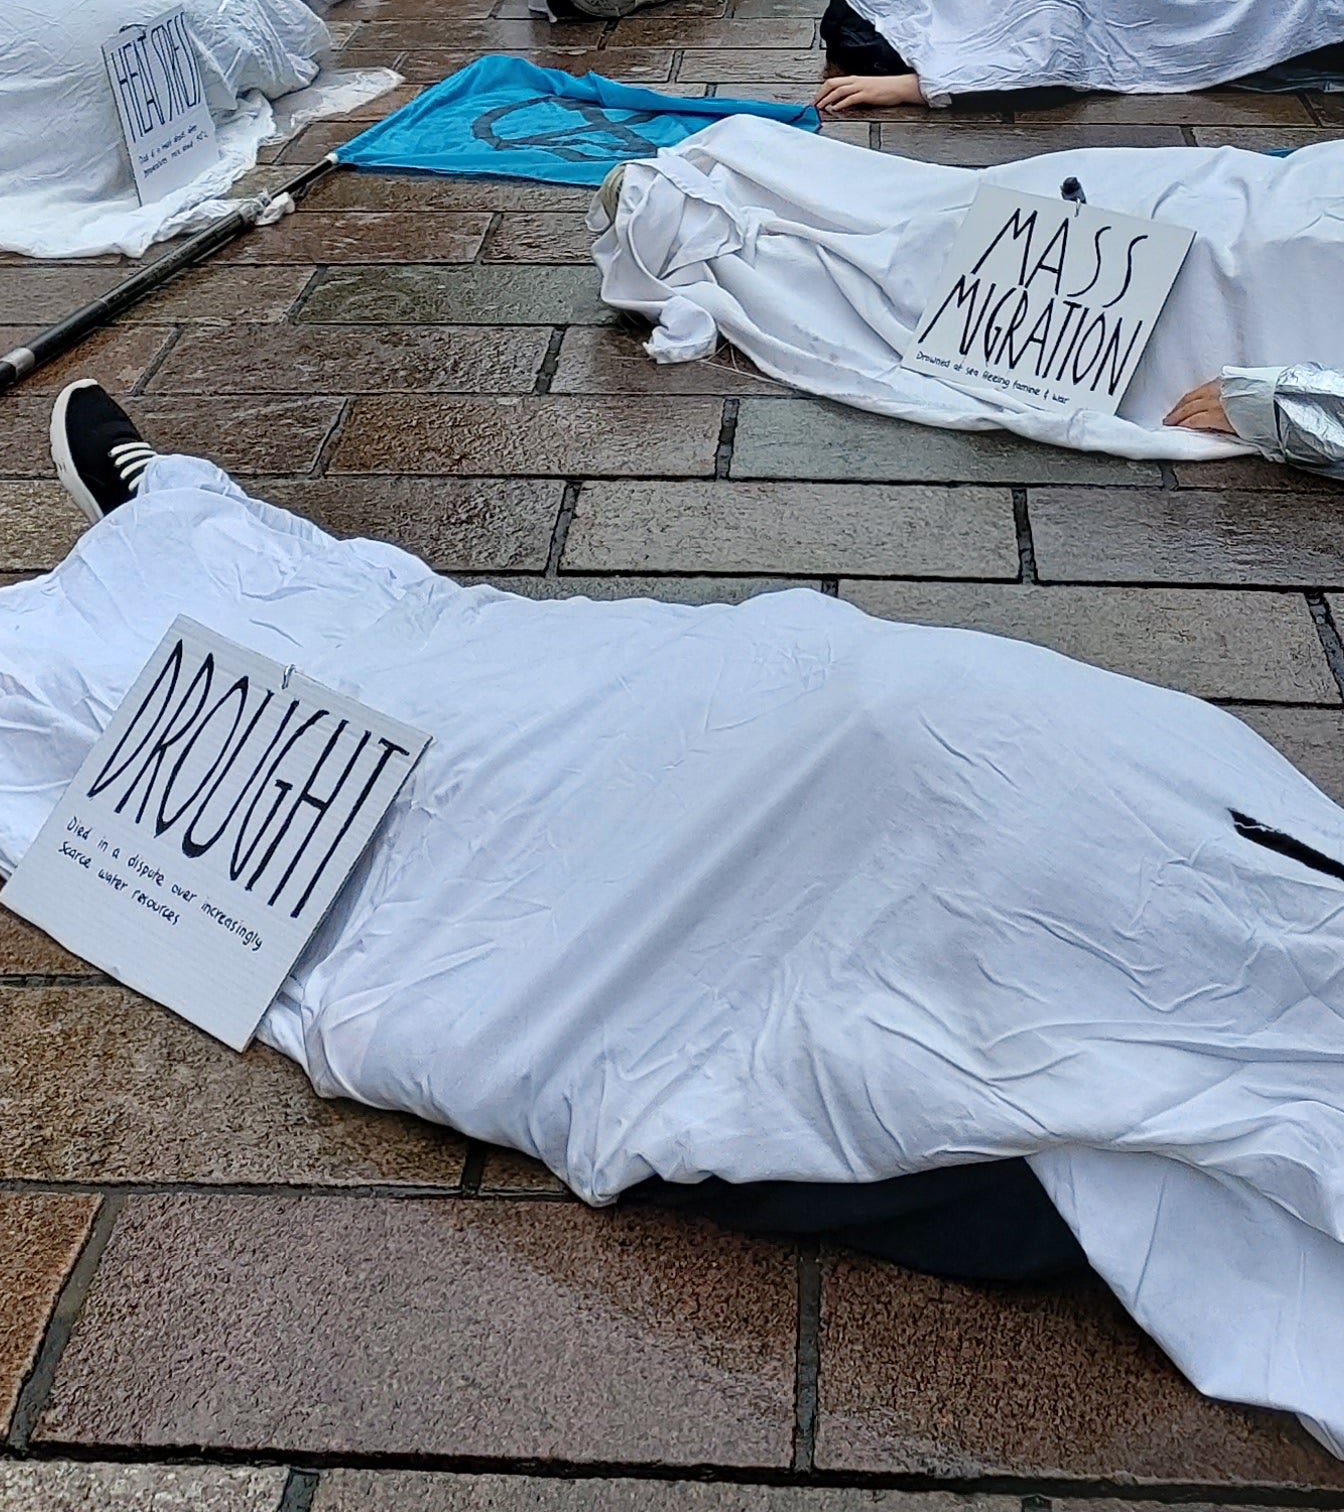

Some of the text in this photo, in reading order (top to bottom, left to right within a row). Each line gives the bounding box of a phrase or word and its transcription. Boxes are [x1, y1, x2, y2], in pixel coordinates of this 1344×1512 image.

[111, 35, 166, 144] HEAT
[971, 206, 1149, 308] MASS
[916, 350, 951, 370] Drowned
[953, 362, 964, 373] at
[965, 366, 979, 378] sea
[982, 370, 1010, 390] fleeing
[1012, 378, 1041, 397] famine
[1052, 394, 1070, 405] war
[917, 273, 1143, 397] MIGRATION
[87, 638, 411, 919] DROUGHT
[66, 816, 264, 952] Died in a dispute over increasingly
[98, 869, 130, 893] water
[131, 885, 182, 928] resources
